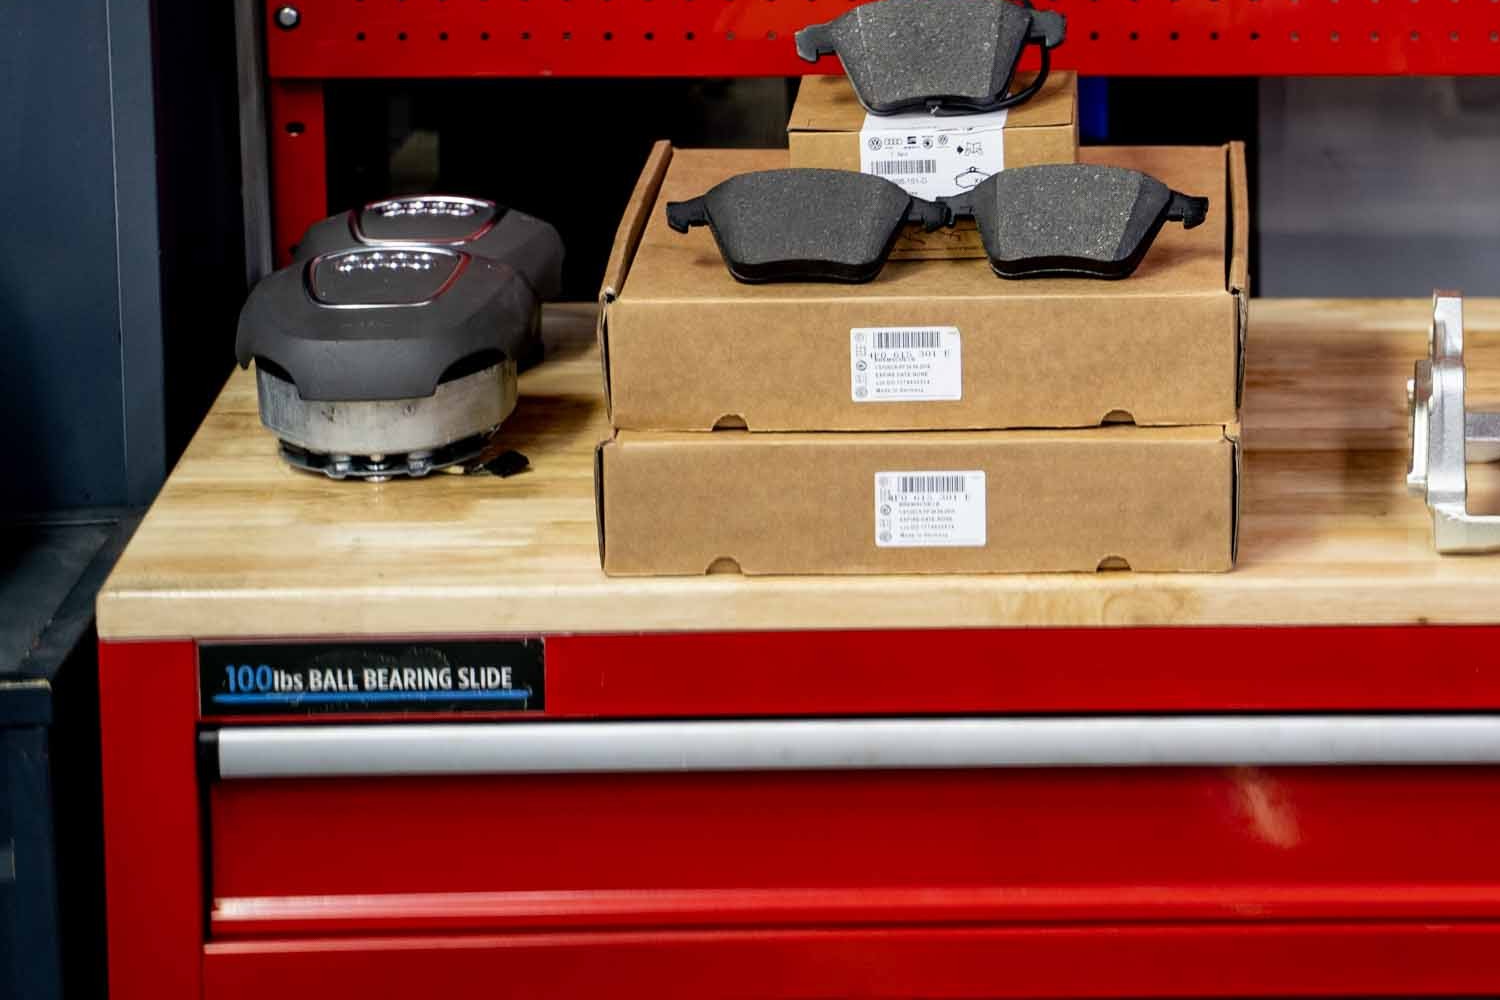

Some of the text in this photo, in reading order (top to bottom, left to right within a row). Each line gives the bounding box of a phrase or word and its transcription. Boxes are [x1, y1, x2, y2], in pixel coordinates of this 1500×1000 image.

[225, 664, 513, 693] 100lbs BALL BEARING SLIDE
